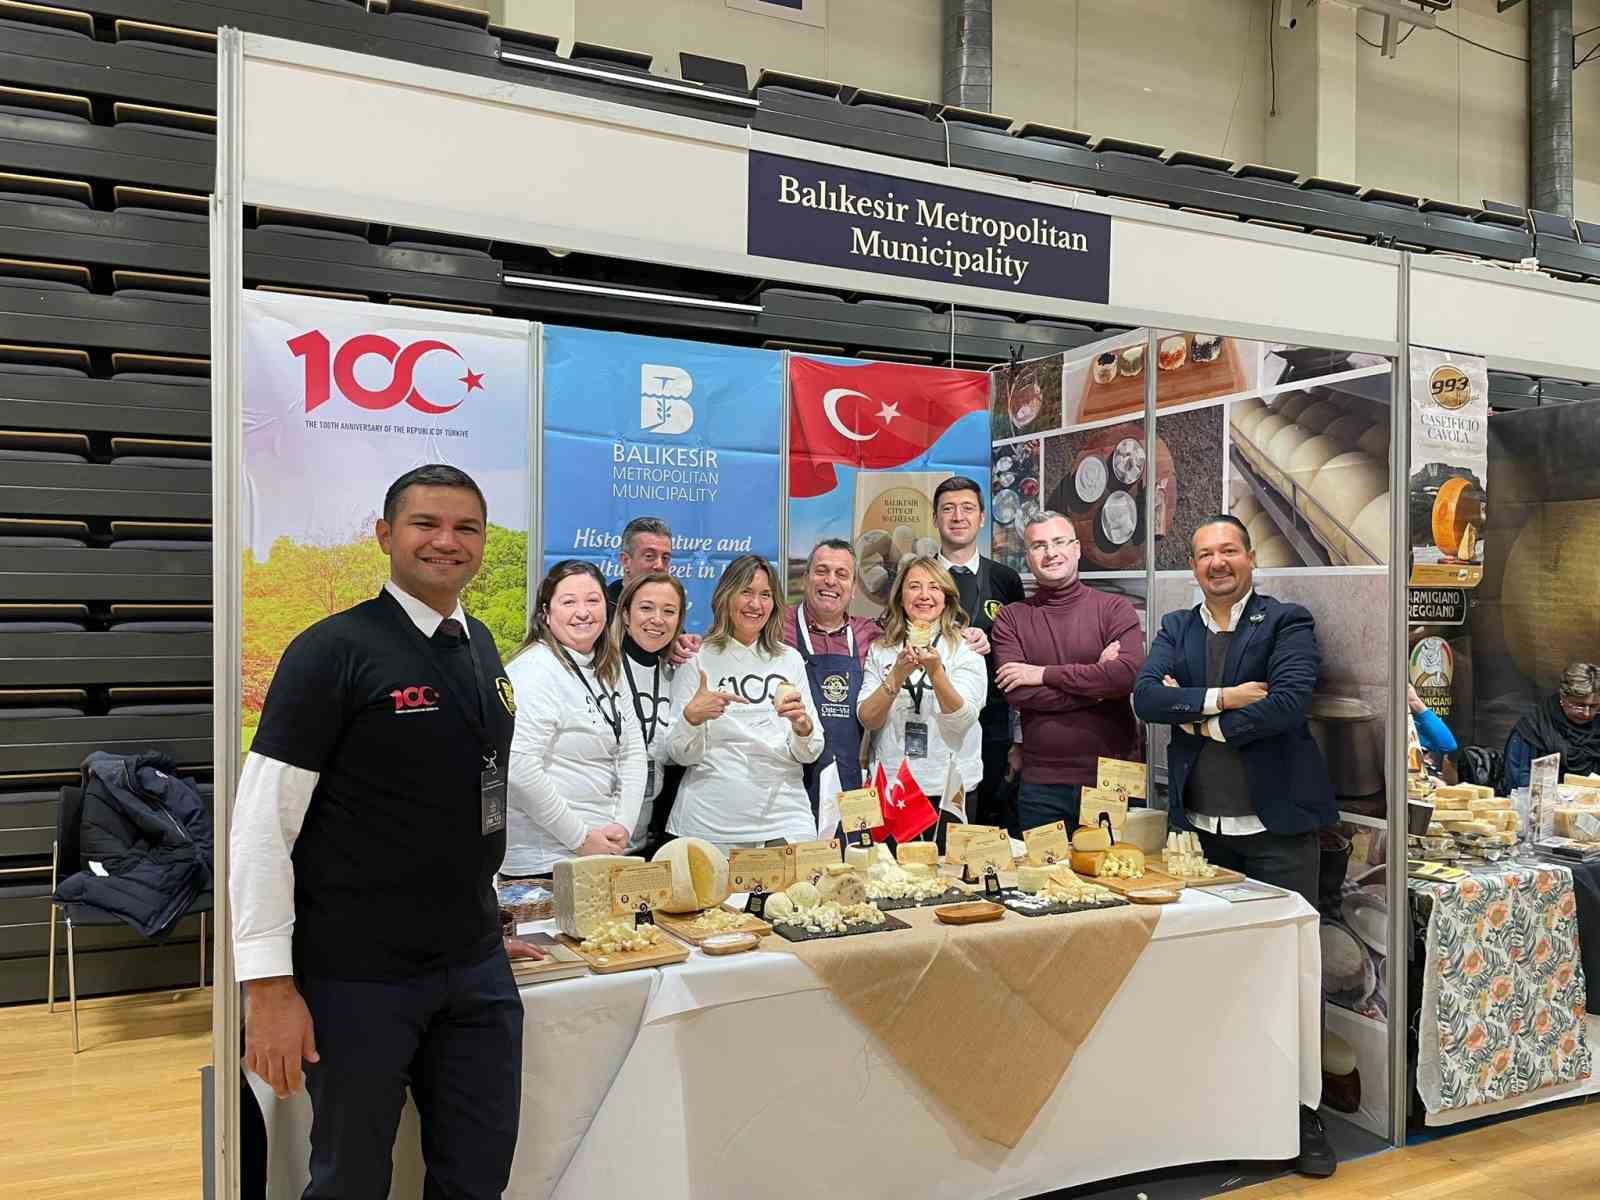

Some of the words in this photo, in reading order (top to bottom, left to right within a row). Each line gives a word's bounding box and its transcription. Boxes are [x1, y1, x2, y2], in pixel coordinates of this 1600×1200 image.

[778, 174, 910, 223] Balıkesir
[915, 199, 1089, 253] Metropolitan
[849, 227, 1029, 286] Municipality
[285, 328, 465, 414] 100
[1431, 377, 1470, 395] 993
[305, 420, 317, 429] THE
[340, 422, 383, 432] ANNIVERSARY
[384, 424, 391, 433] OF
[394, 425, 405, 434] THE
[407, 426, 434, 435] REPUBLIC
[1420, 415, 1480, 433] CASEIFICIO
[613, 466, 719, 485] METROPOLITAN
[612, 483, 718, 502] MUNICIPALITY
[573, 528, 623, 550] Histo
[717, 535, 753, 552] and
[668, 563, 692, 578] eet
[697, 560, 715, 578] in
